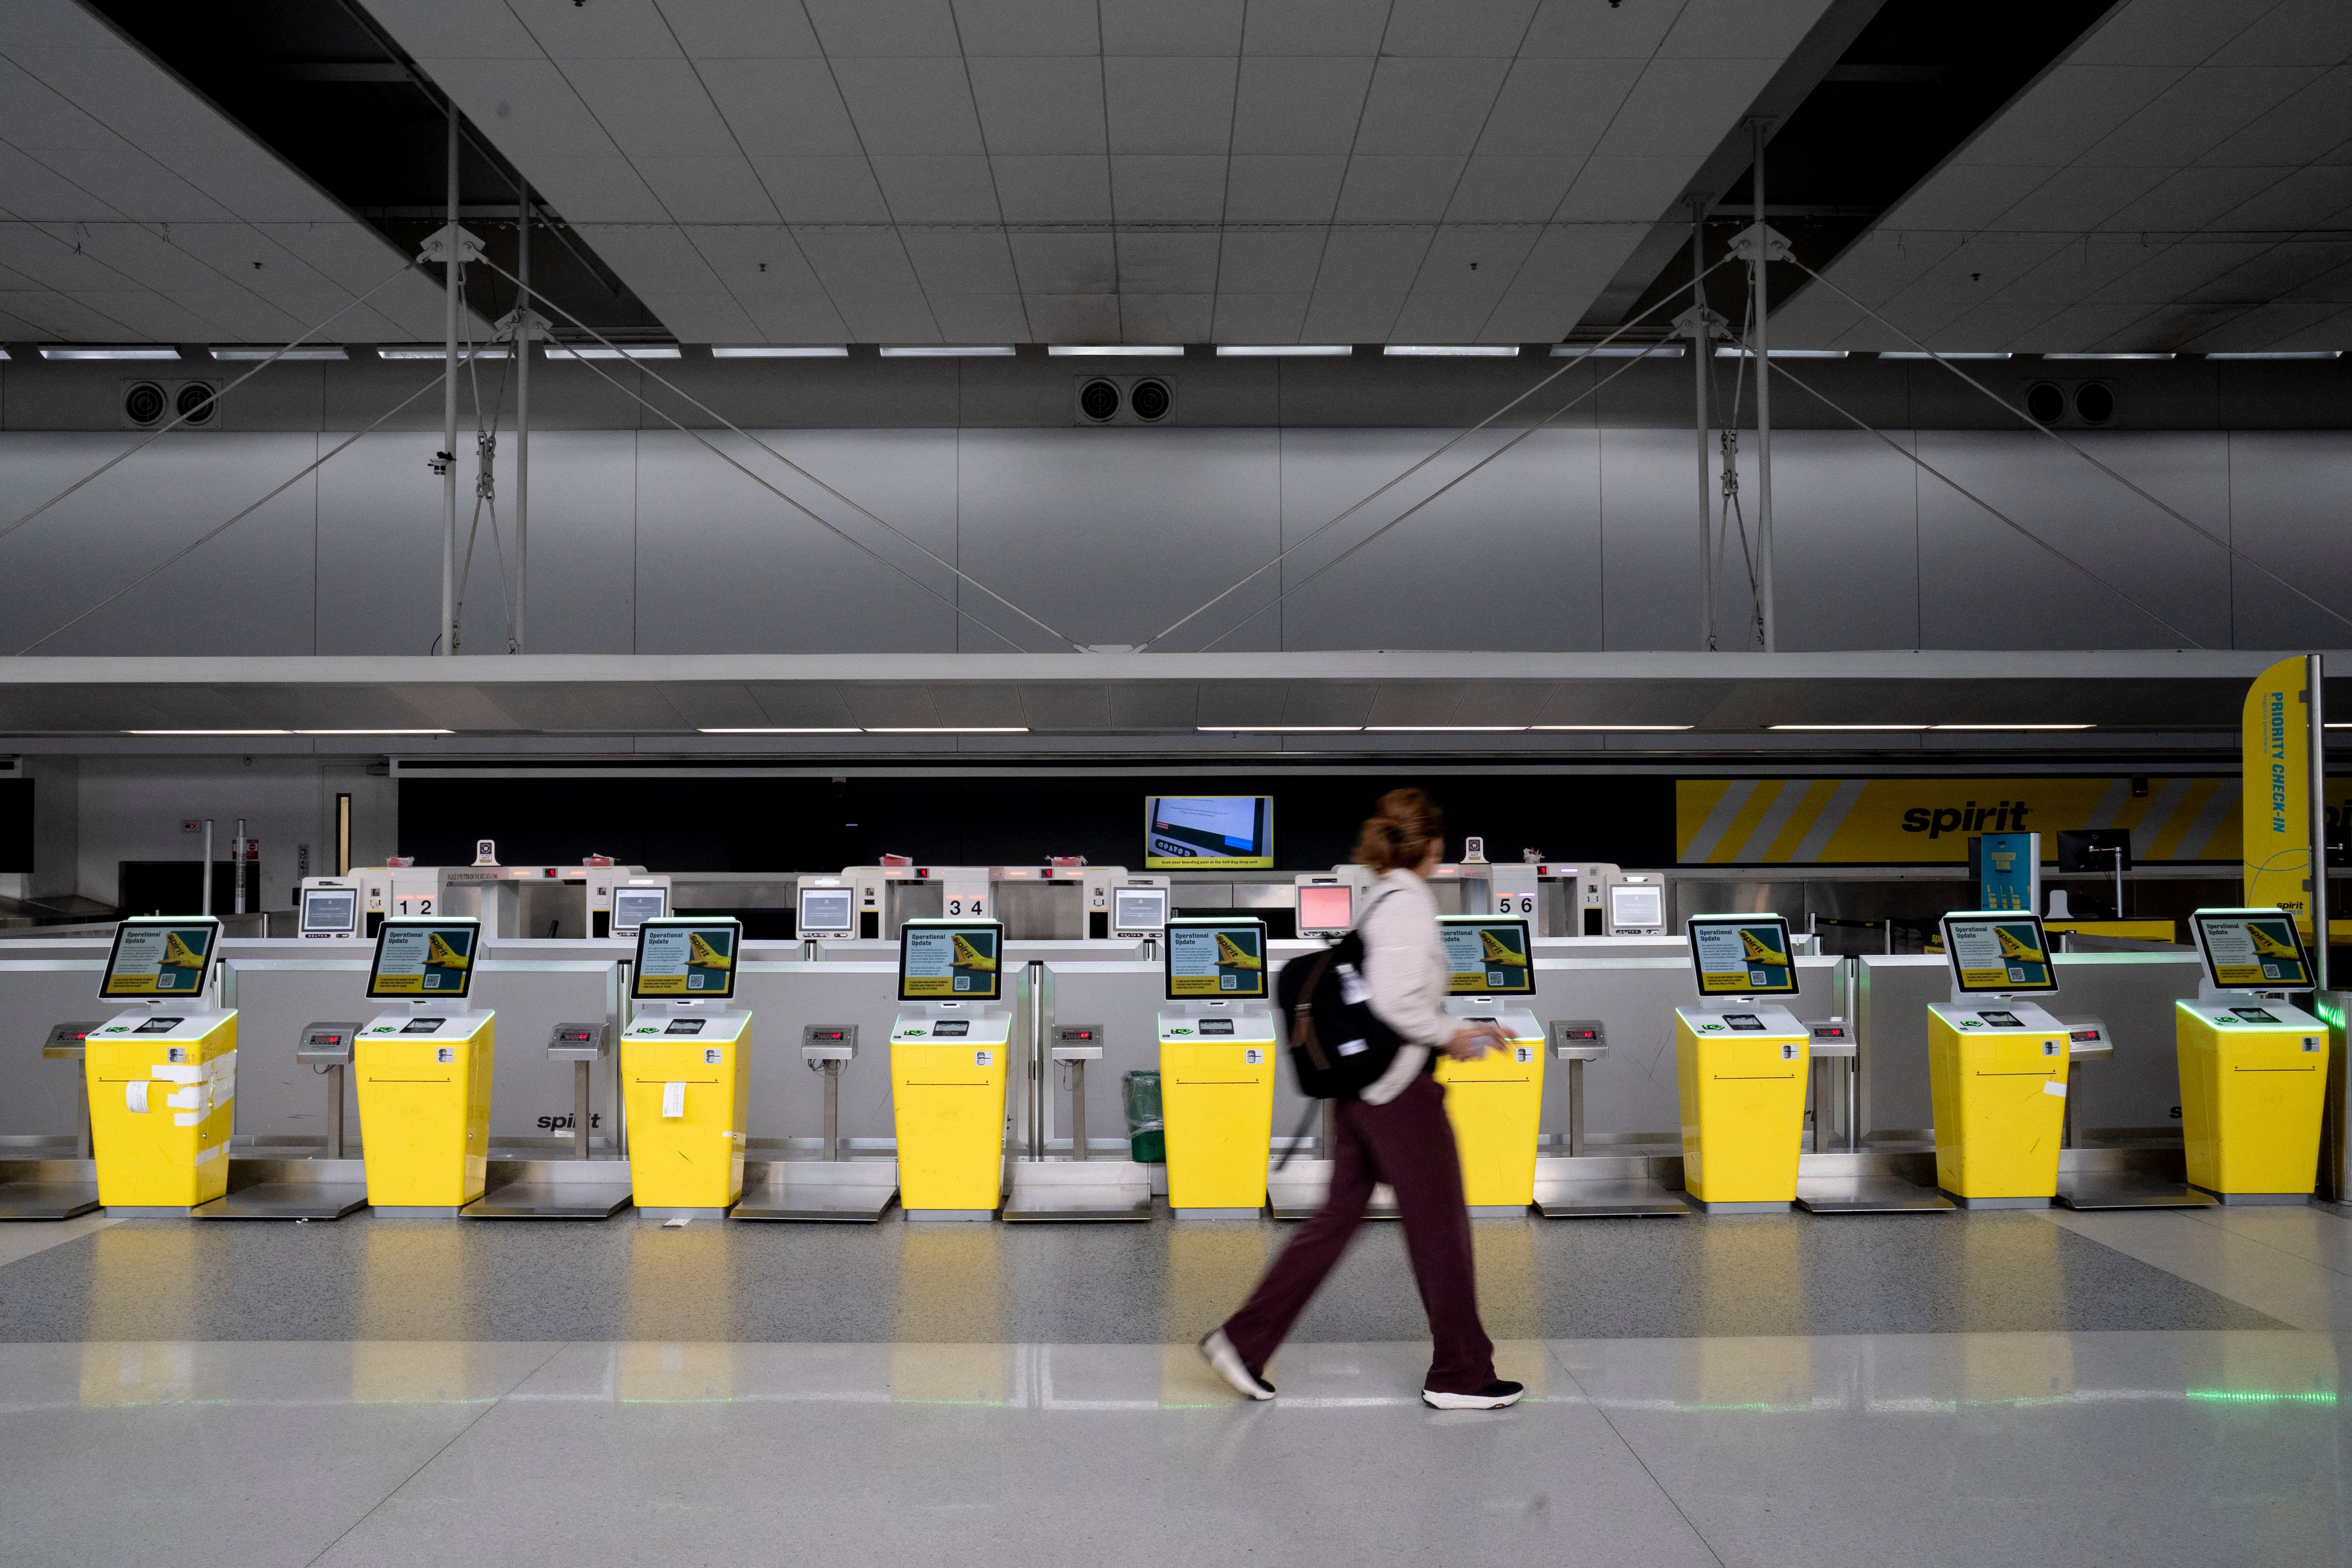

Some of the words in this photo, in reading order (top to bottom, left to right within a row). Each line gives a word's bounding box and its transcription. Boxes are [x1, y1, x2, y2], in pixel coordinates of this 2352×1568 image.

[2271, 692, 2284, 760] PRIORITY
[2272, 764, 2285, 833] CHECK-IN
[1902, 801, 2029, 839] spirit
[400, 901, 407, 915] 1
[421, 900, 431, 915] 2
[950, 901, 961, 916] 3
[971, 901, 982, 915] 4
[1500, 899, 1510, 913] 5
[1521, 899, 1532, 913] 6
[2277, 902, 2304, 910] spirit
[167, 934, 184, 956] spirit
[430, 935, 448, 956] spirit
[691, 935, 710, 957] spirit
[1217, 935, 1239, 957] spirit
[1481, 933, 1503, 955] spirit
[1740, 931, 1764, 953] spirit
[1996, 929, 2020, 950] spirit
[2248, 926, 2273, 947] spirit
[953, 937, 974, 959] spirit
[537, 1113, 600, 1132] spit
